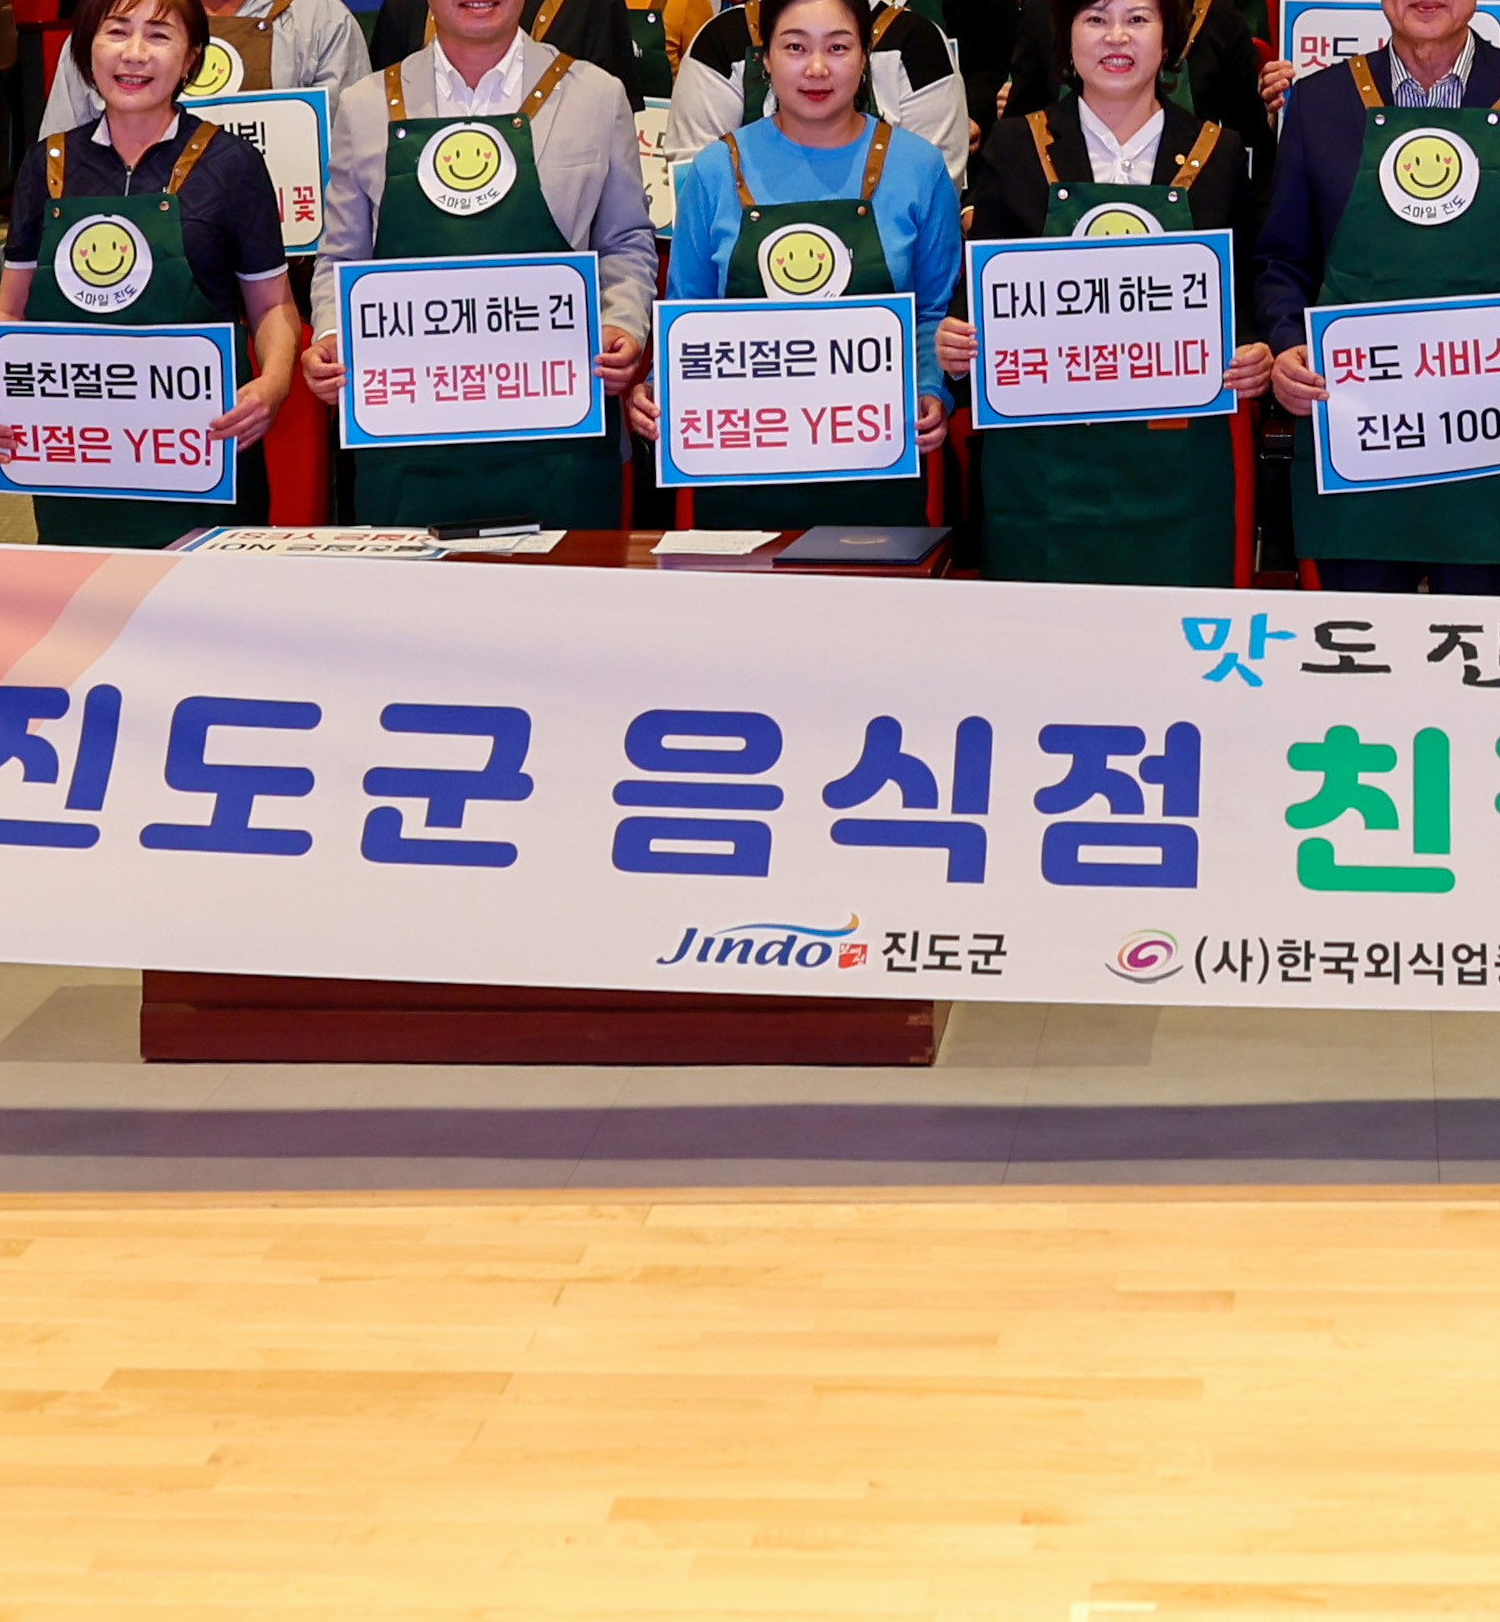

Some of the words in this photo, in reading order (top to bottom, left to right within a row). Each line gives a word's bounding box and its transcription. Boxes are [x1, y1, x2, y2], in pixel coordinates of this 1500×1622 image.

[435, 194, 471, 210] 스마일
[475, 188, 500, 207] 진도
[1400, 203, 1439, 219] 스마일
[1441, 196, 1466, 215] 진도
[73, 289, 109, 307] 스마일
[113, 285, 137, 304] 진도
[361, 301, 413, 338] 다시
[424, 298, 476, 335] 오게
[486, 297, 539, 332] 하는
[549, 294, 574, 329] 건
[992, 281, 1045, 318] 다시
[1056, 278, 1109, 315] 오게
[1119, 276, 1173, 312] 하는
[1183, 273, 1207, 309] 건
[680, 340, 817, 379] 불친절은
[830, 337, 891, 374] NO!
[995, 348, 1048, 386] 결국
[1058, 339, 1209, 381] '친절'입니다
[1333, 345, 1402, 384] 맛도
[3, 362, 137, 399] 불친절은
[150, 365, 211, 400] NO!
[363, 368, 416, 405] 결국
[426, 360, 576, 401] '친절'입니다
[7, 425, 112, 464] 친절은
[124, 429, 214, 467] YES!
[680, 408, 789, 449] 친절은
[801, 404, 891, 444] YES!
[1358, 413, 1425, 451] 진심
[1182, 613, 1391, 687] 맛도
[612, 709, 1201, 888] 음식점
[882, 931, 1007, 975] 진도군
